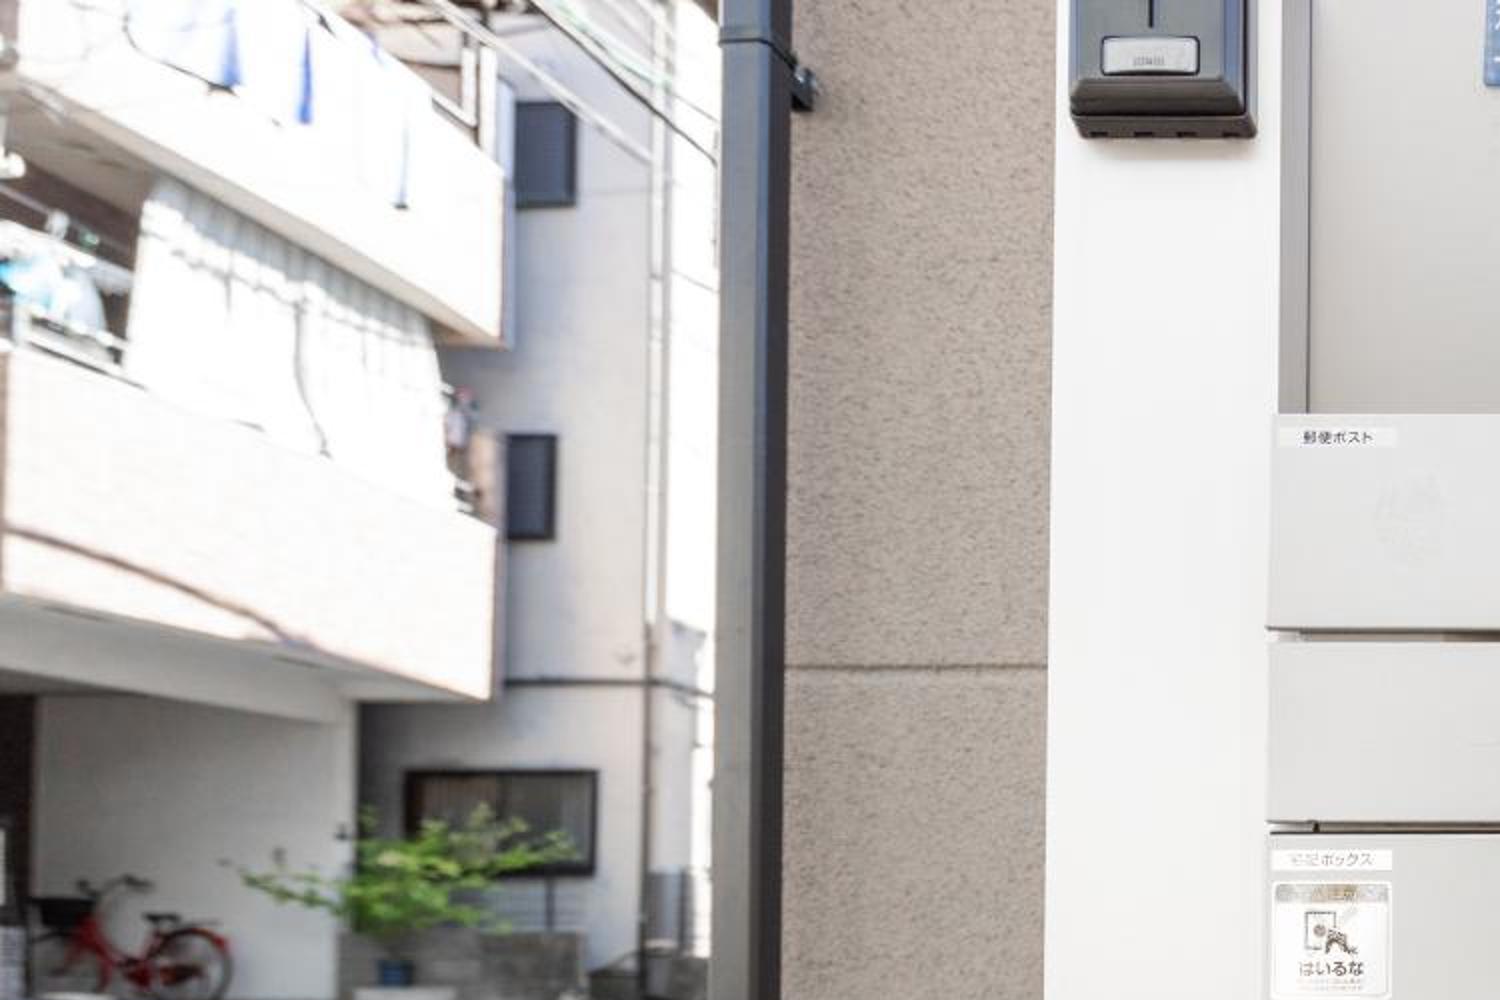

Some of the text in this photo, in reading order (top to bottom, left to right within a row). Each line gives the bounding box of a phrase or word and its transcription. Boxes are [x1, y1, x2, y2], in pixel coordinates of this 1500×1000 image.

[1302, 431, 1374, 444] 郵便ポスト
[1299, 961, 1365, 976] はいるな
